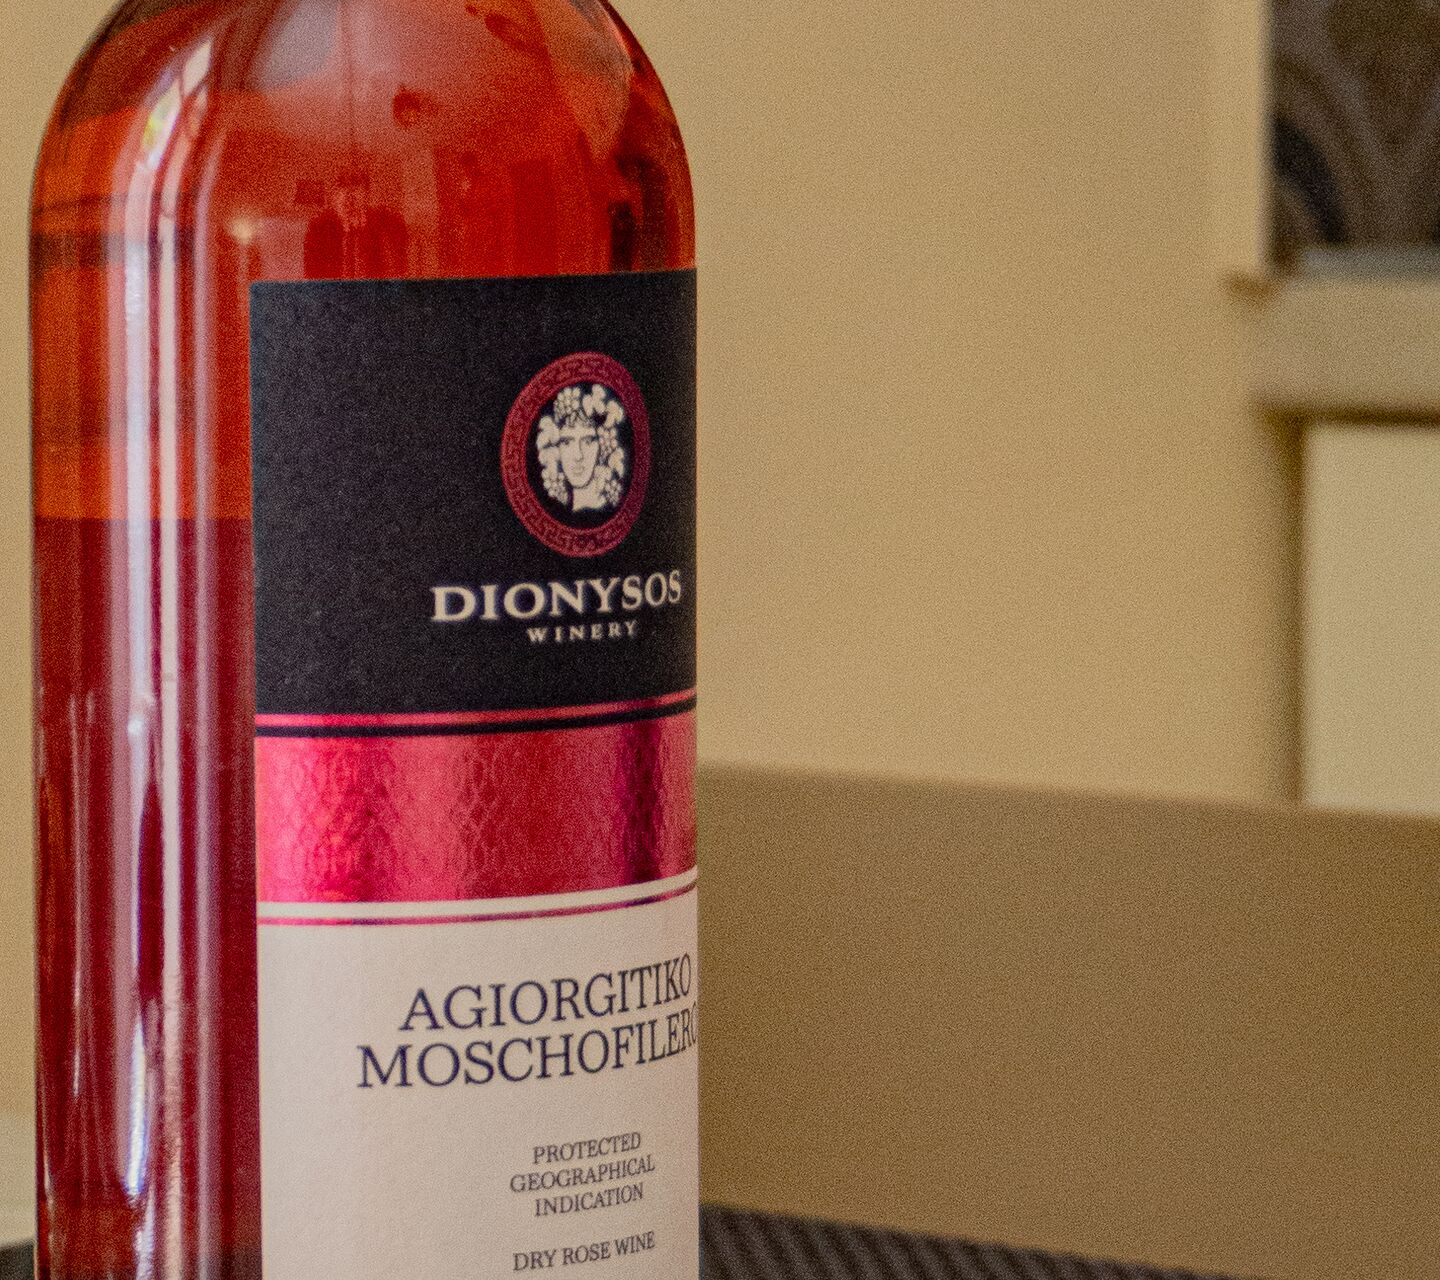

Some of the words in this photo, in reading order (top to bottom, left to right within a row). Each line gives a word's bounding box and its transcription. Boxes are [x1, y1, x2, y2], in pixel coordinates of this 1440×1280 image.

[430, 570, 682, 623] DIONYSOS
[526, 621, 639, 644] WINERY
[398, 952, 692, 1031] AGIORGITIKO
[532, 1132, 642, 1164] PROTECTED
[510, 1154, 656, 1193] GEOGRAPHICAL
[534, 1182, 644, 1217] INDICATION
[512, 1248, 558, 1272] DRY
[562, 1239, 611, 1266] ROSE
[615, 1230, 656, 1256] WINE
